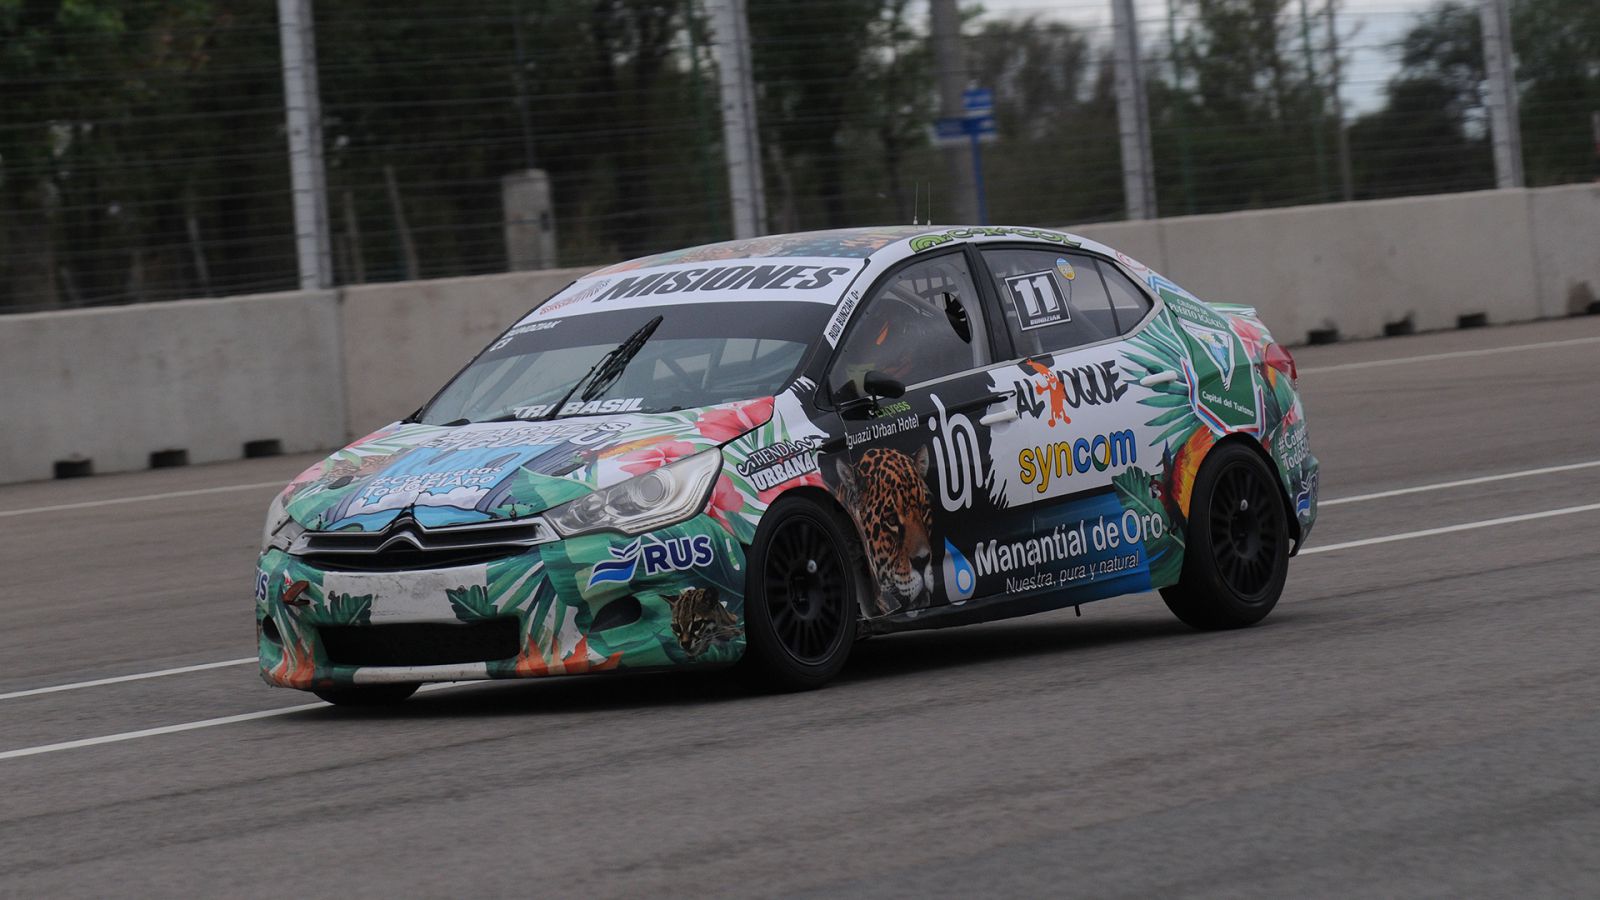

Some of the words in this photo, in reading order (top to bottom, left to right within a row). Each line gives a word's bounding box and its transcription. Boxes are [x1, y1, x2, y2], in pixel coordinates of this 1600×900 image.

[591, 264, 851, 303] MISIONES
[1014, 275, 1060, 317] 11
[513, 398, 644, 419] TRBASIL
[1014, 379, 1045, 419] AL
[1202, 391, 1222, 404] Capital
[1223, 399, 1232, 408] del
[1233, 401, 1254, 417] Turismo
[872, 422, 897, 439] Urban
[897, 413, 920, 432] Hotel
[749, 440, 799, 469] TIENDA
[750, 450, 817, 491] URBANA
[1018, 429, 1137, 494] syncom
[641, 534, 714, 576] RUS
[974, 519, 1088, 577] Manantial
[1092, 515, 1120, 551] de
[1121, 508, 1164, 545] Oro
[1005, 570, 1057, 595] Nuestra,
[1060, 564, 1086, 587] pura
[1089, 561, 1097, 581] y
[1099, 550, 1140, 574] natural
